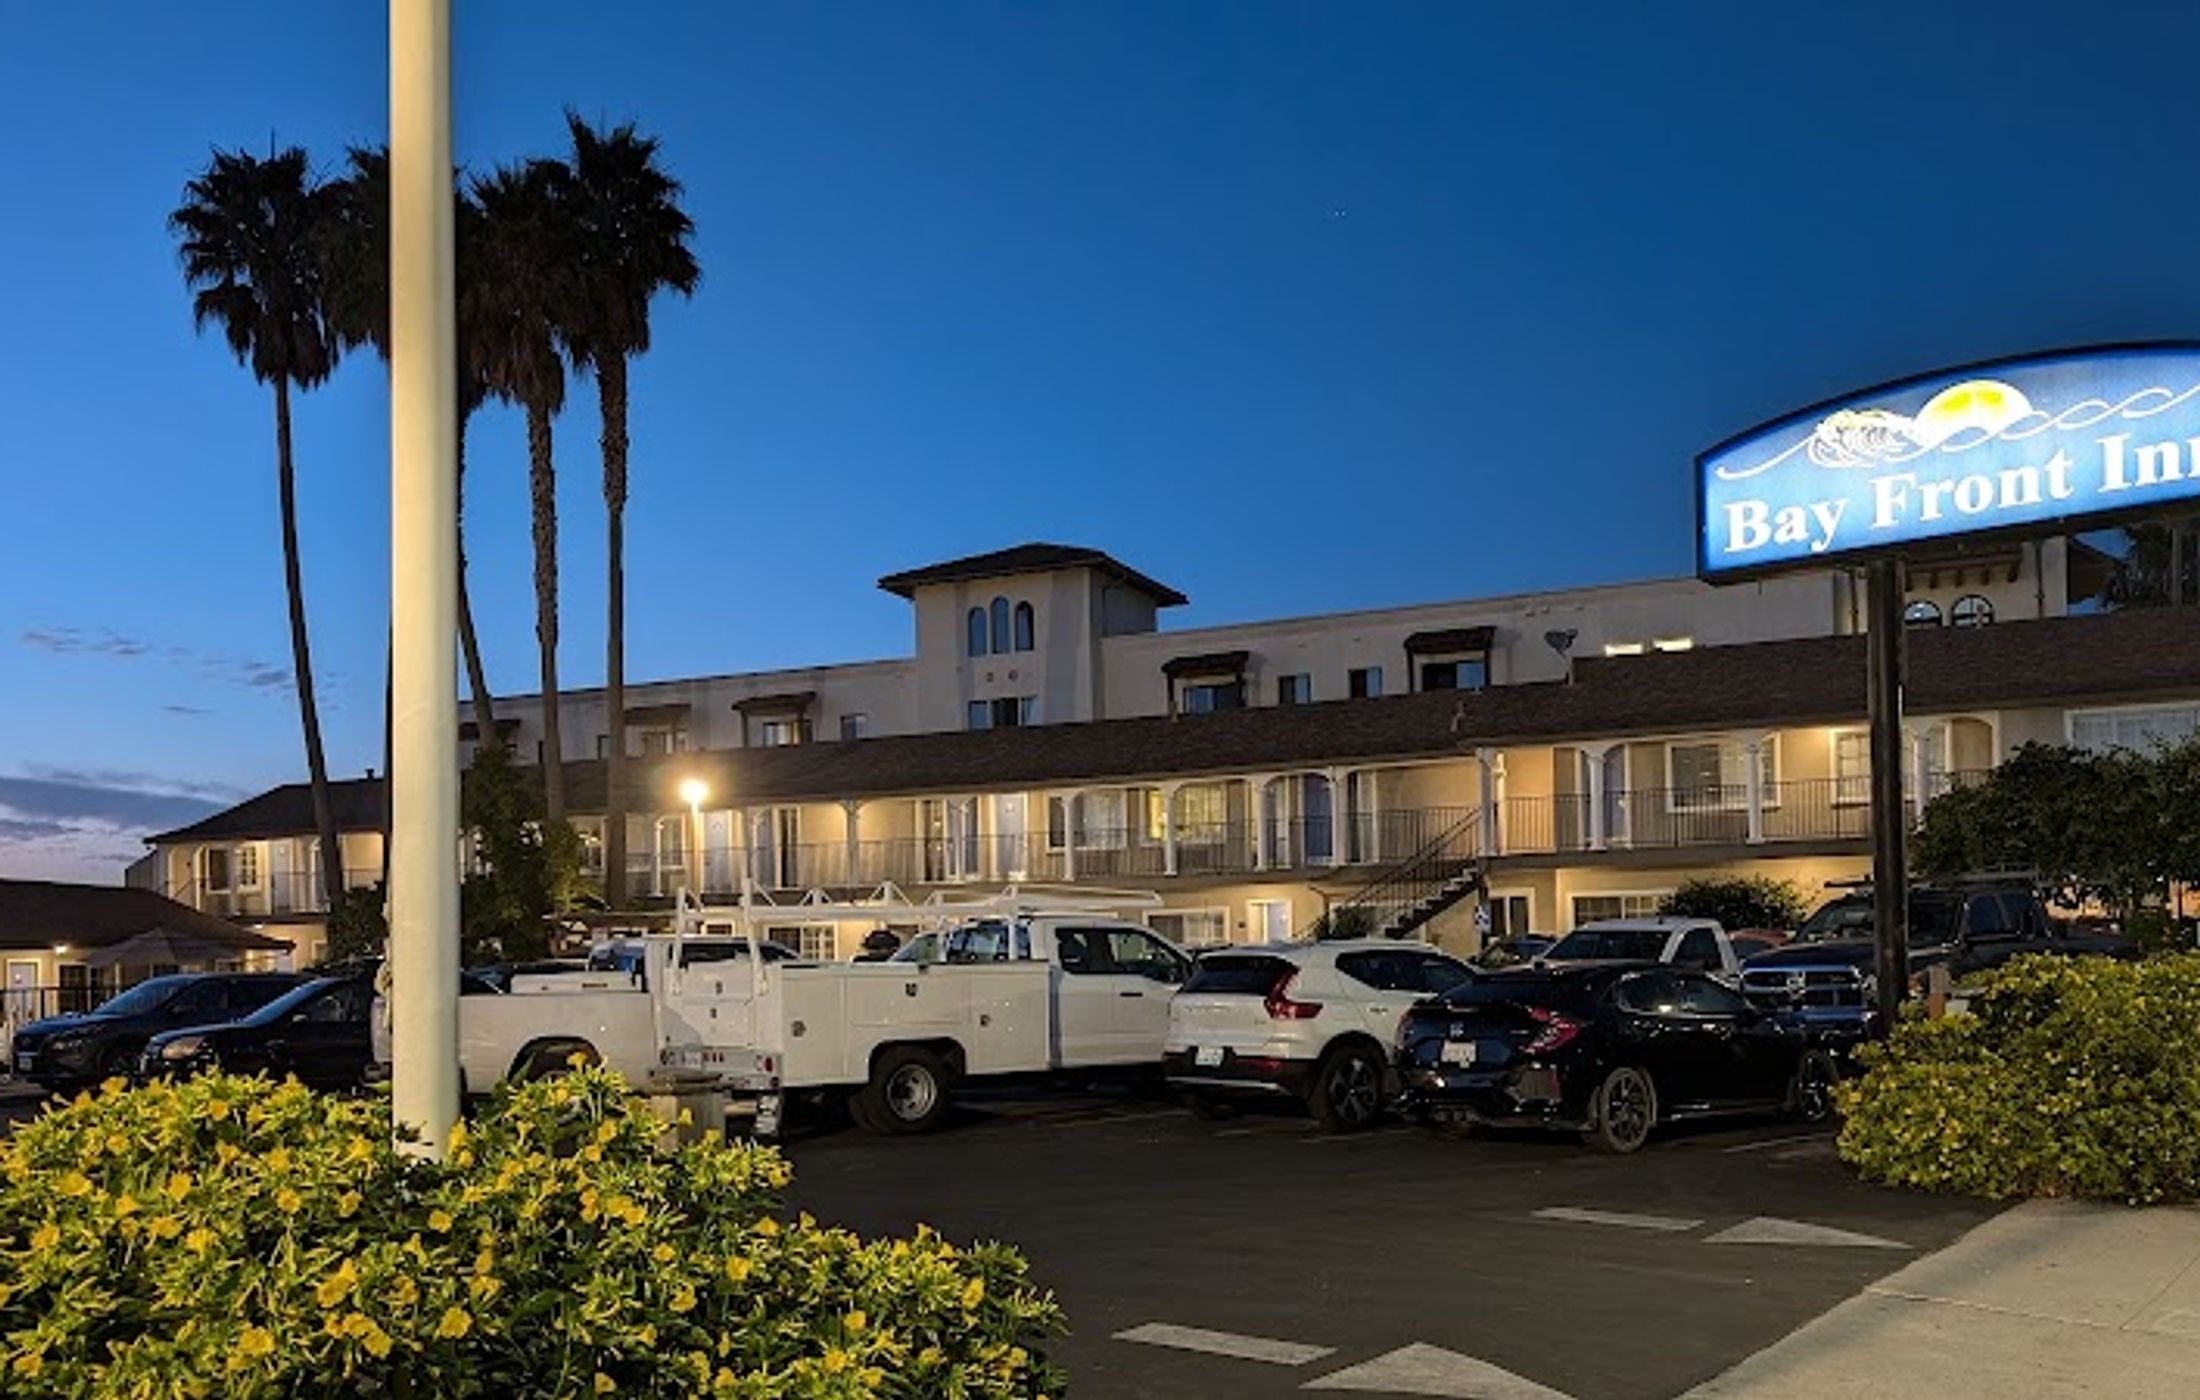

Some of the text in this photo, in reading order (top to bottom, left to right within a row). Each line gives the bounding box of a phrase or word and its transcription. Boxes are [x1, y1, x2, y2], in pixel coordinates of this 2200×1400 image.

[1723, 432, 2200, 553] Bay Front In
